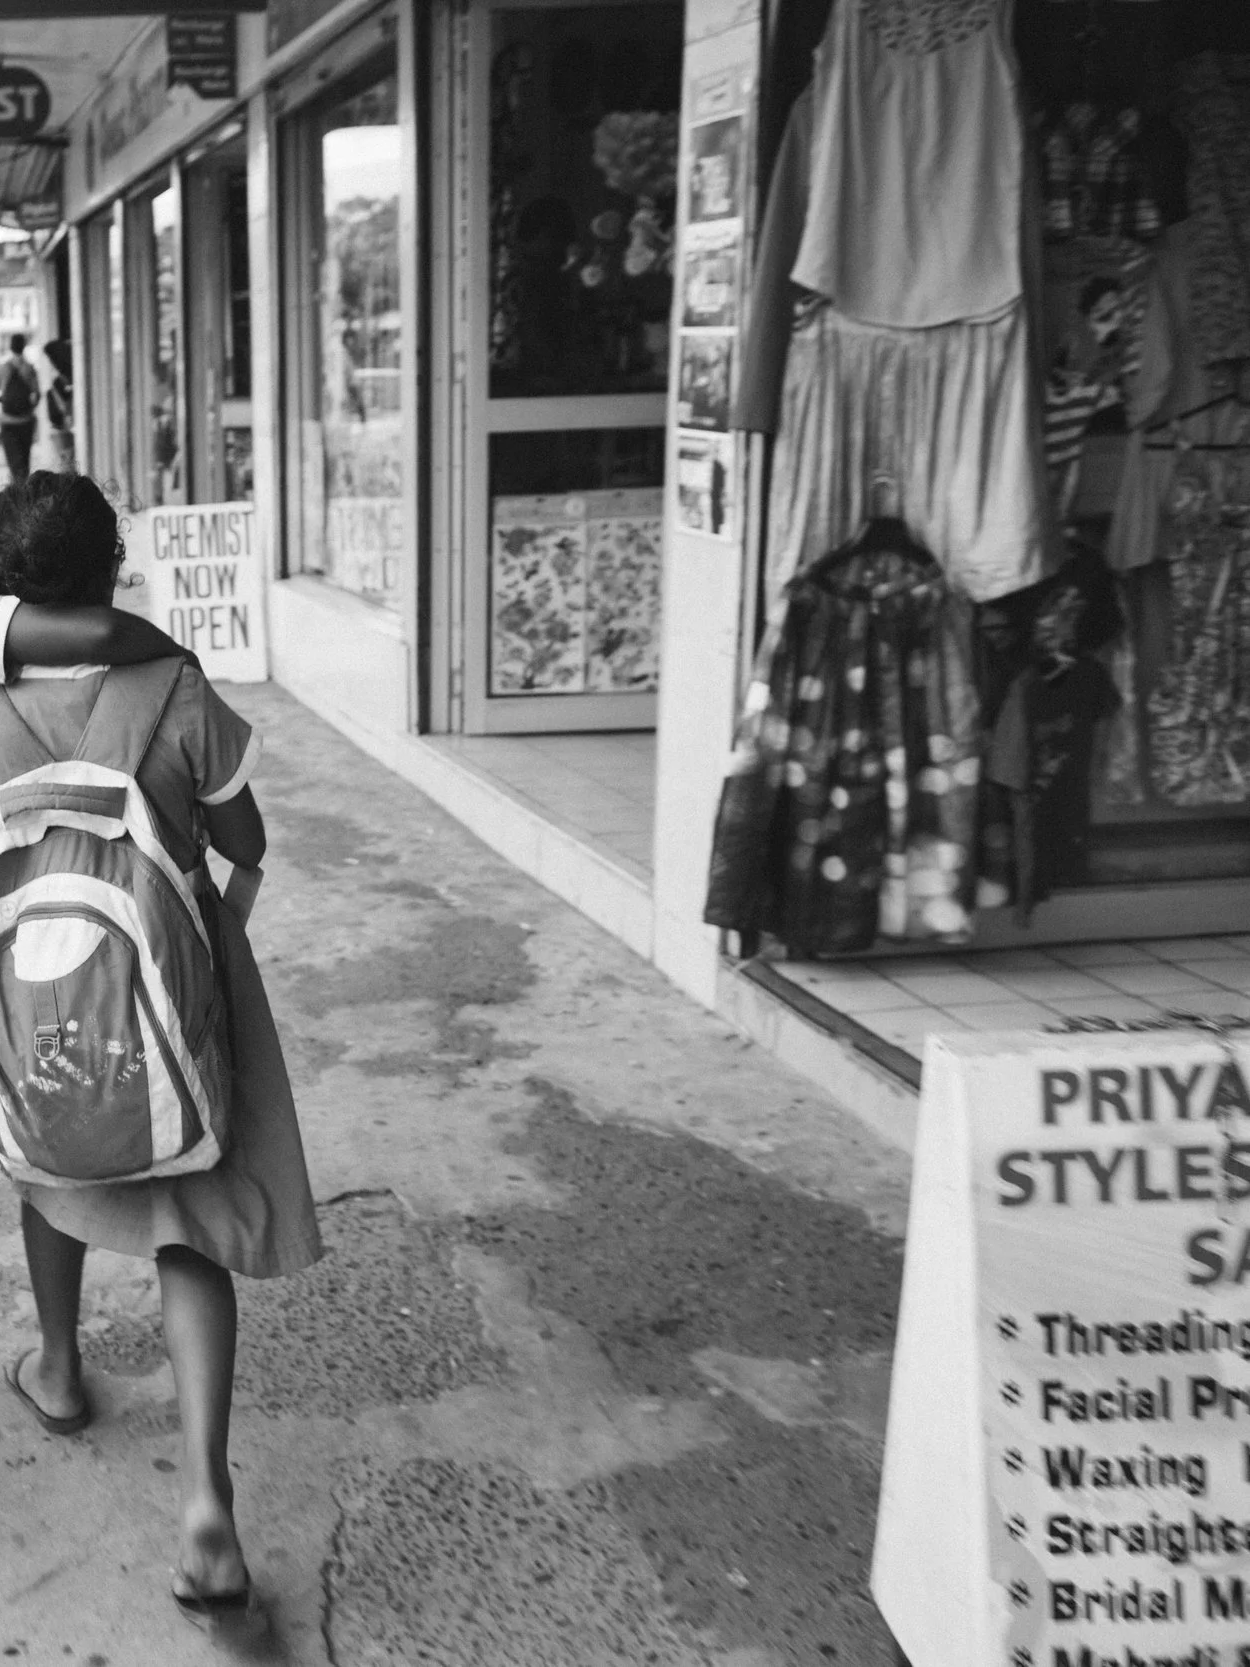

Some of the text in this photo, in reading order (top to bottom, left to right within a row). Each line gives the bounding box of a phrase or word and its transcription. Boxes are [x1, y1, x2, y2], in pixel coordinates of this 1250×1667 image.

[153, 511, 252, 560] CHEMIST
[174, 563, 236, 599] NOW
[1040, 1063, 1250, 1125] PRIYA
[997, 1142, 1250, 1207] STYLES
[1040, 1375, 1250, 1424] Facial Pr
[1040, 1443, 1208, 1497] Waxing
[1046, 1510, 1250, 1566] Straight
[1051, 1576, 1186, 1623] Bridal
